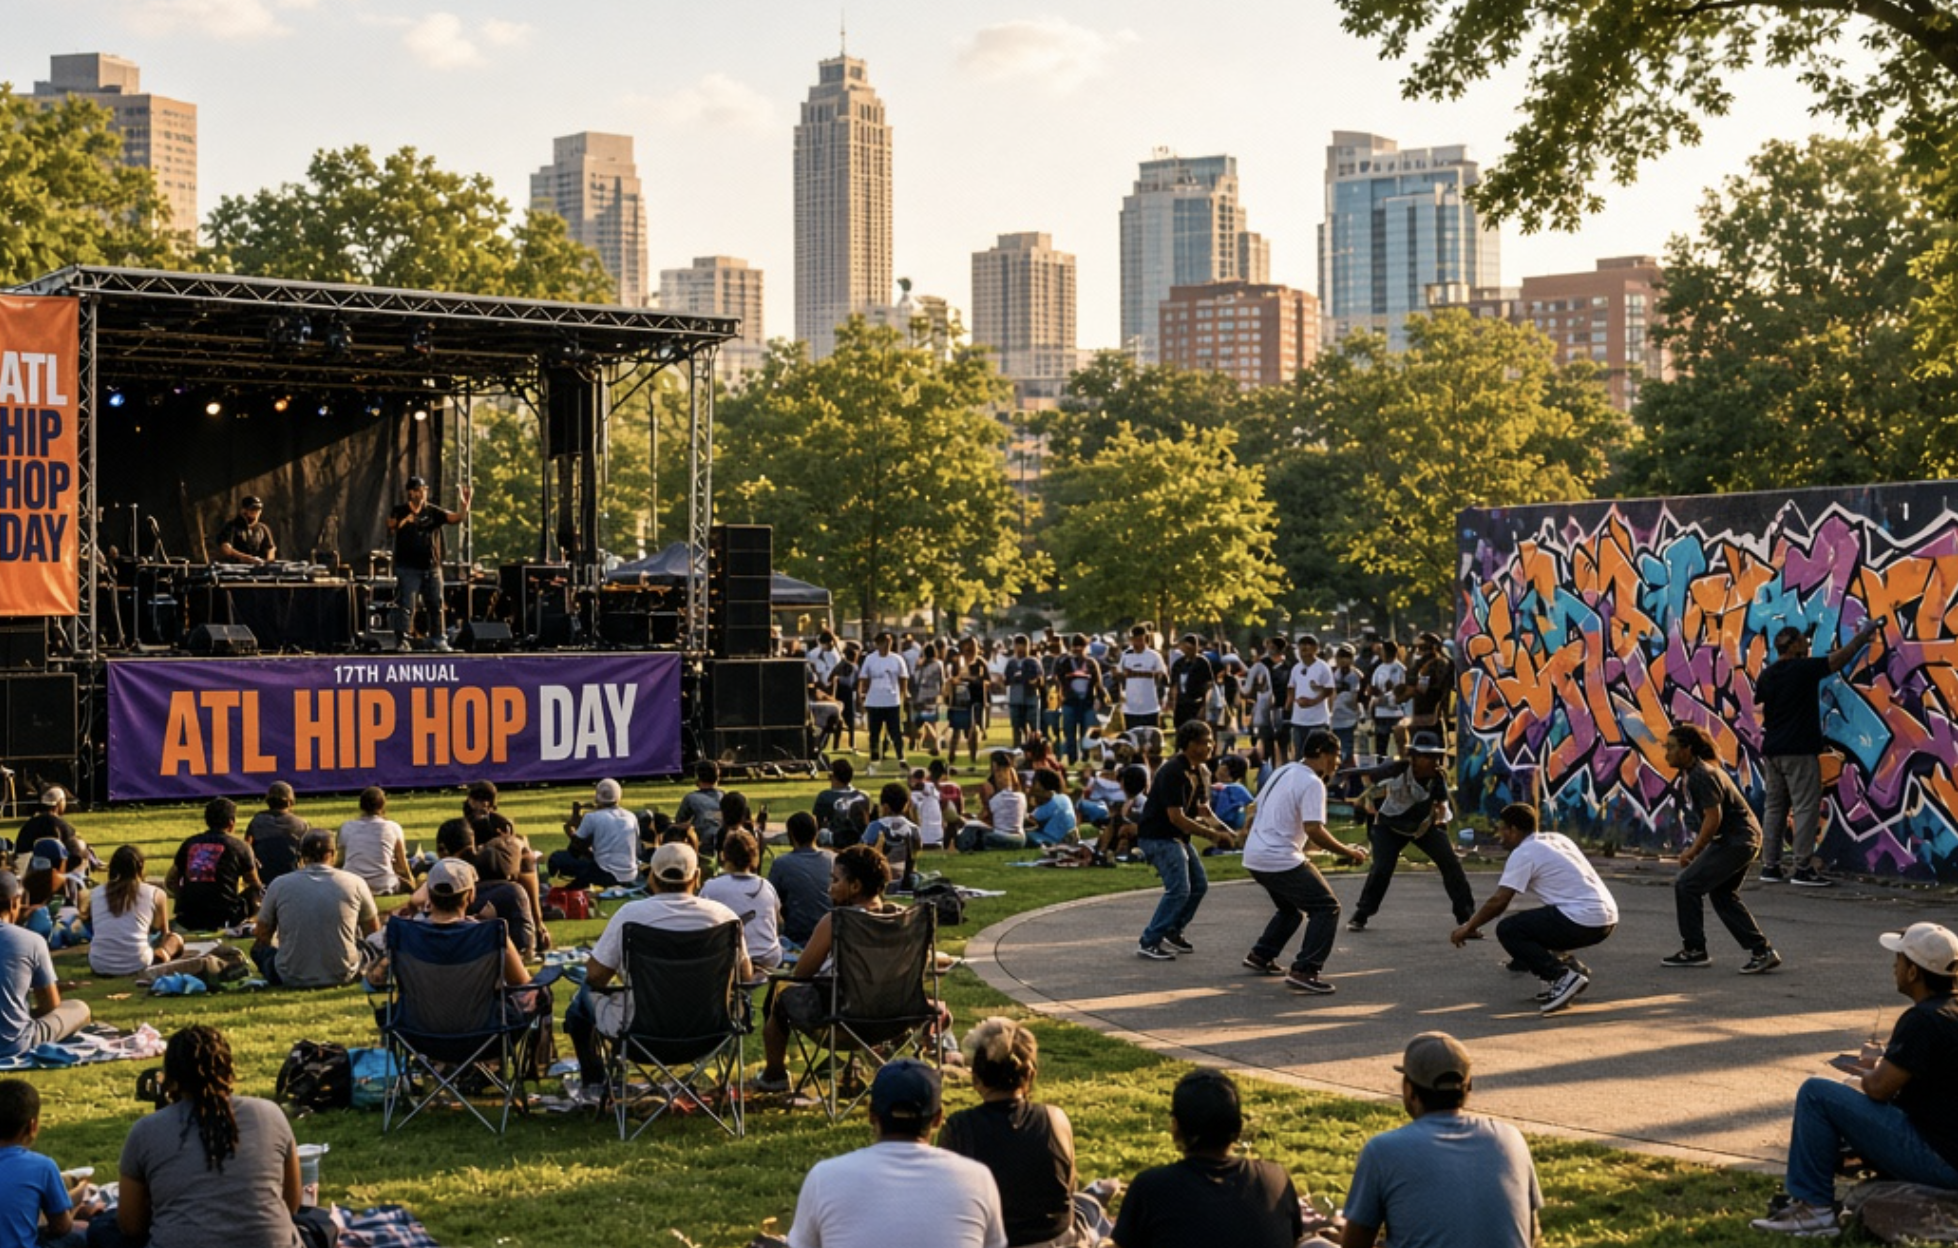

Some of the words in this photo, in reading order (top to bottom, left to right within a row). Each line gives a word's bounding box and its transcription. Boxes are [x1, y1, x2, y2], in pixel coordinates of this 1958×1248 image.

[0, 350, 68, 406] ATL
[0, 406, 63, 457] HIP
[0, 459, 71, 510] HOP
[0, 512, 68, 563] DAY
[334, 664, 379, 684] 17TH
[385, 663, 460, 683] ANNUAL
[160, 690, 277, 776] ATL
[294, 688, 396, 771] HIP
[411, 686, 527, 766] HOP
[539, 683, 638, 761] DAY
